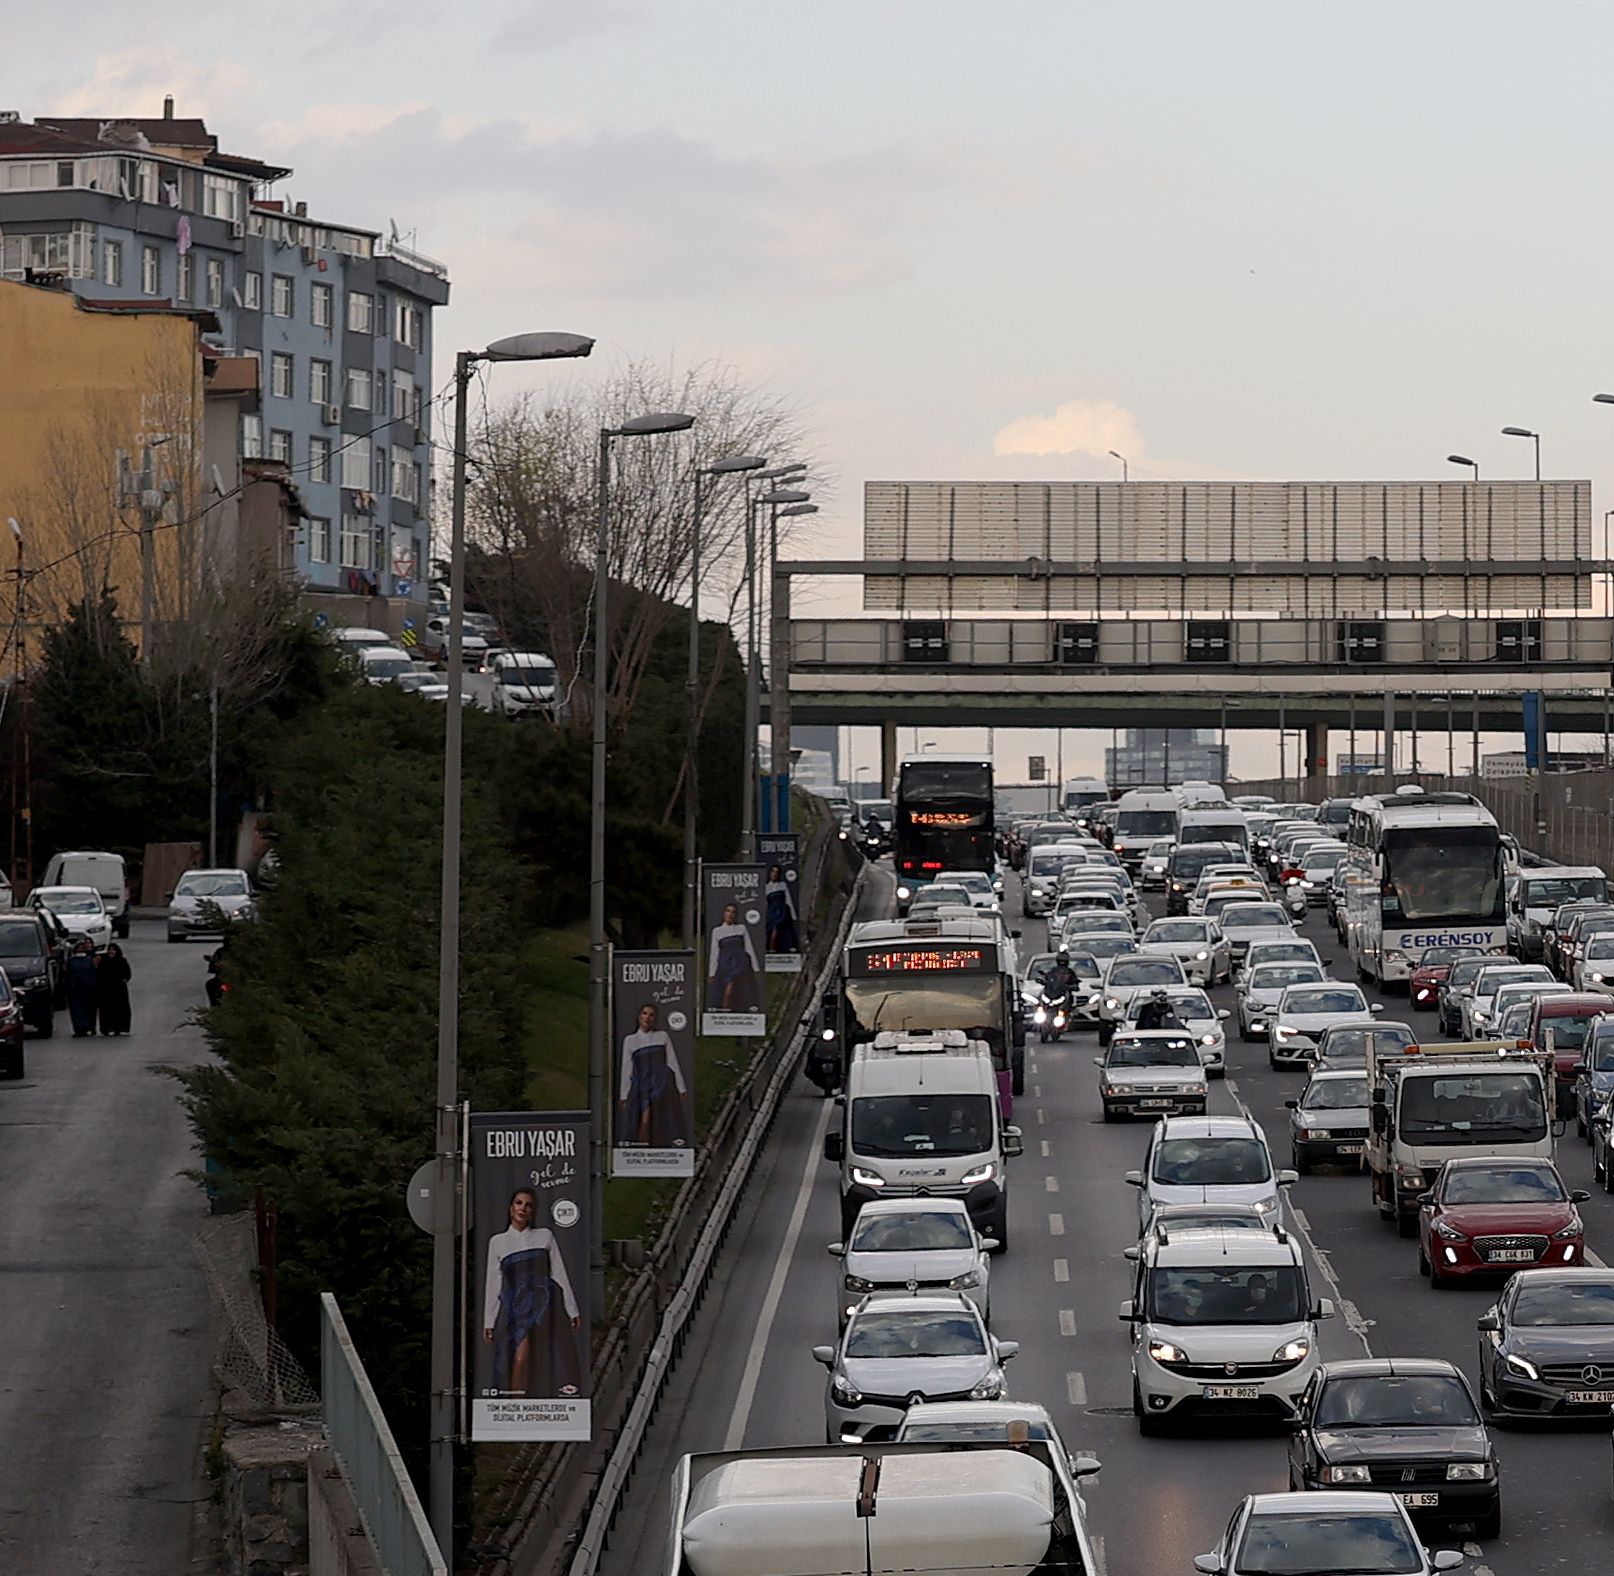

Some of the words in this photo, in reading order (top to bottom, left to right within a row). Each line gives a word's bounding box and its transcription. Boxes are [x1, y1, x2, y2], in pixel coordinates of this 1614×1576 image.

[622, 963, 650, 983] EBRU
[650, 963, 685, 985] YAŞAR
[486, 1131, 525, 1158] EBRU
[527, 1130, 576, 1161] YAŞAR
[1209, 1388, 1219, 1398] 34
[1570, 1392, 1581, 1402] 34
[1403, 1495, 1413, 1504] EA
[1421, 1494, 1437, 1505] 695
